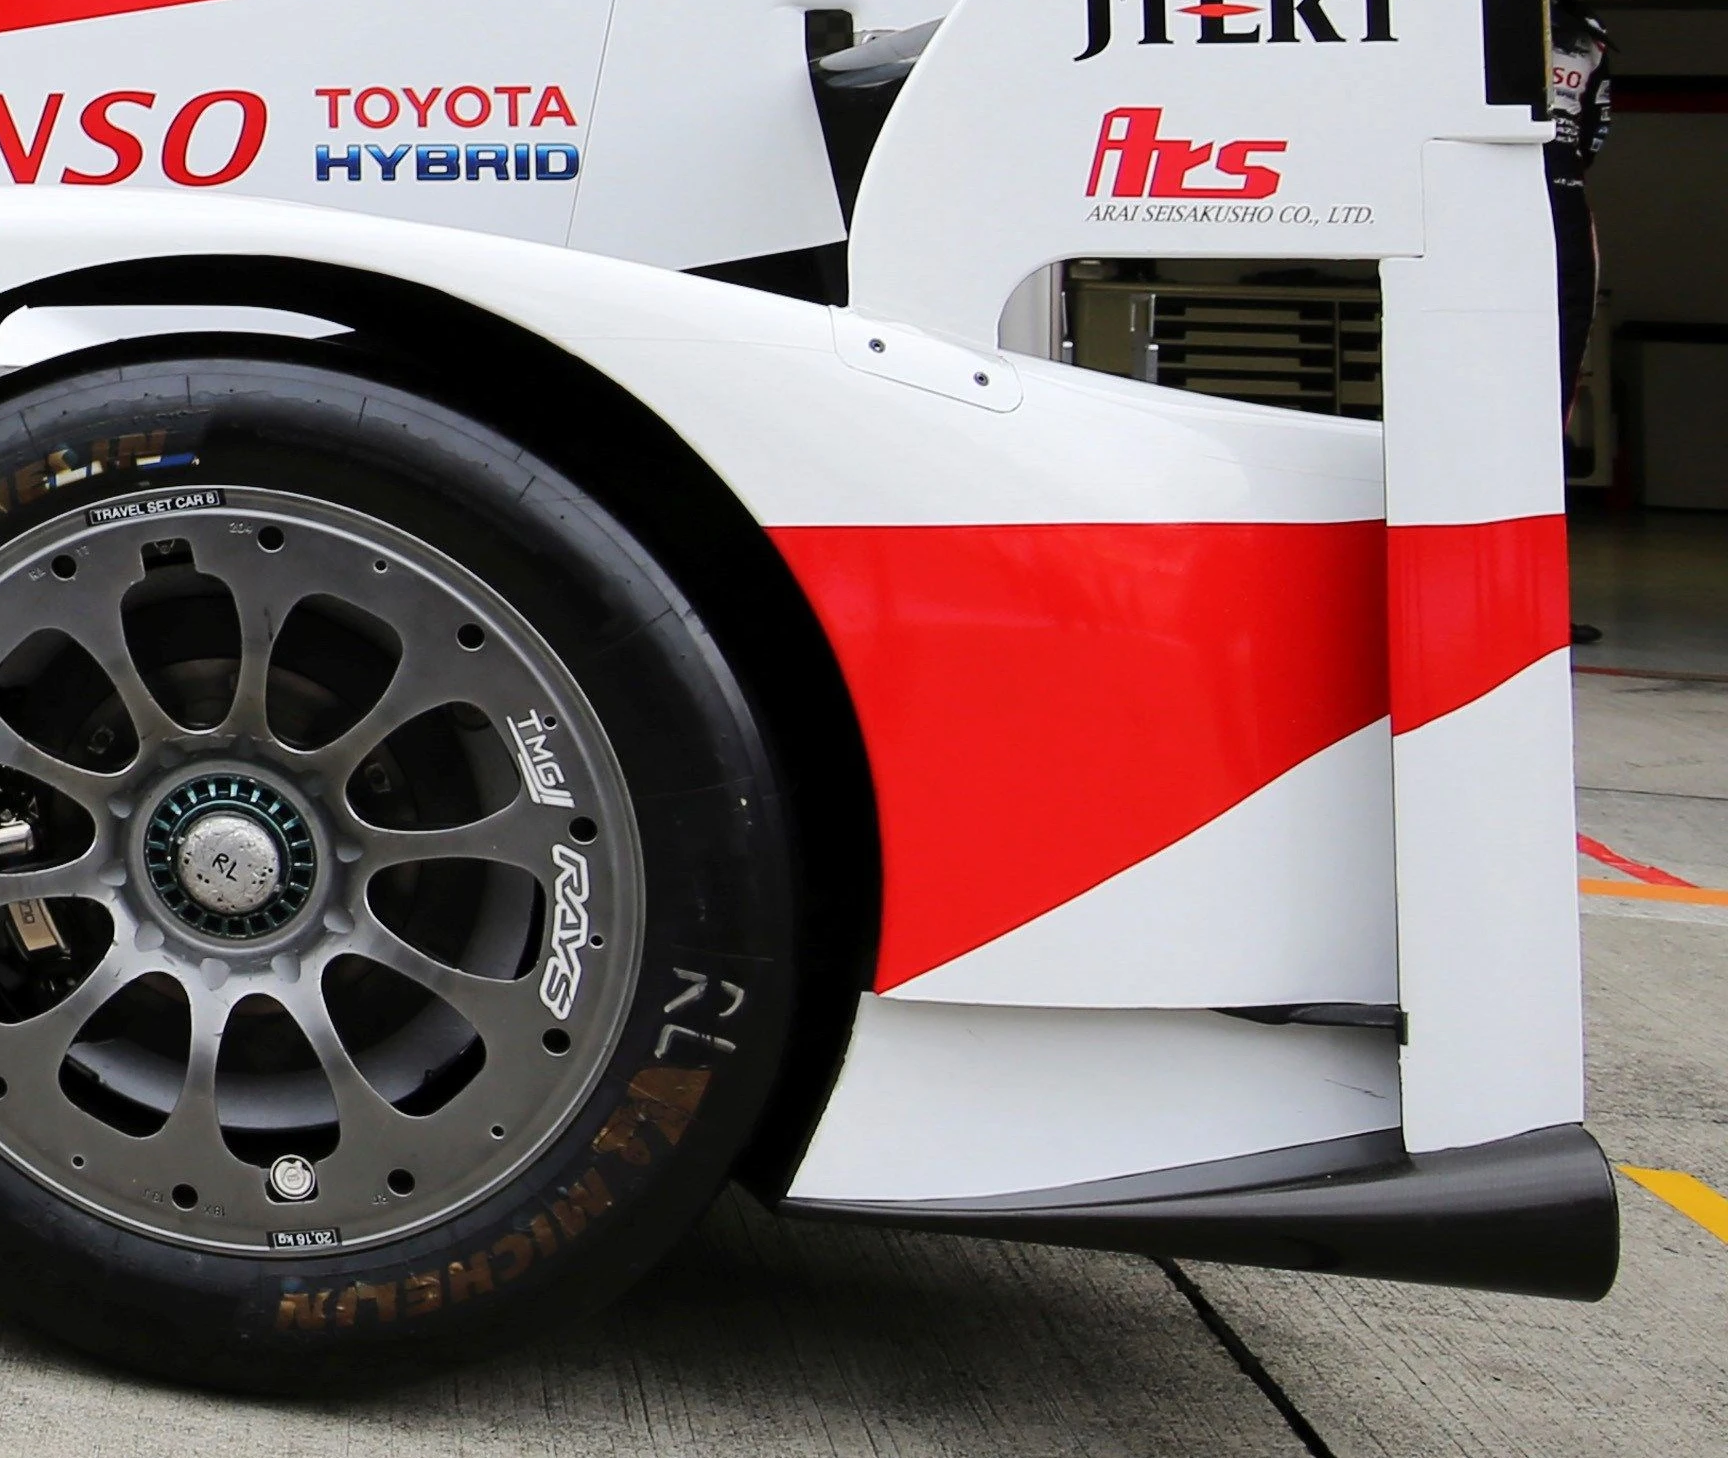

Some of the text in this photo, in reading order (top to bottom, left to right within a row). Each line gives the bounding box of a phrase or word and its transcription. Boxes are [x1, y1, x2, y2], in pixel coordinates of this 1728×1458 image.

[315, 85, 580, 129] TOYOTA
[315, 142, 581, 183] HYBRID
[1084, 204, 1376, 226] ARAI SEISAKUSHO CO., LTD.
[93, 491, 216, 523] TRAVEL SET CAR 8
[211, 852, 238, 883] RL
[539, 843, 591, 1021] RAYS
[277, 1232, 334, 1247] 20,16 kg
